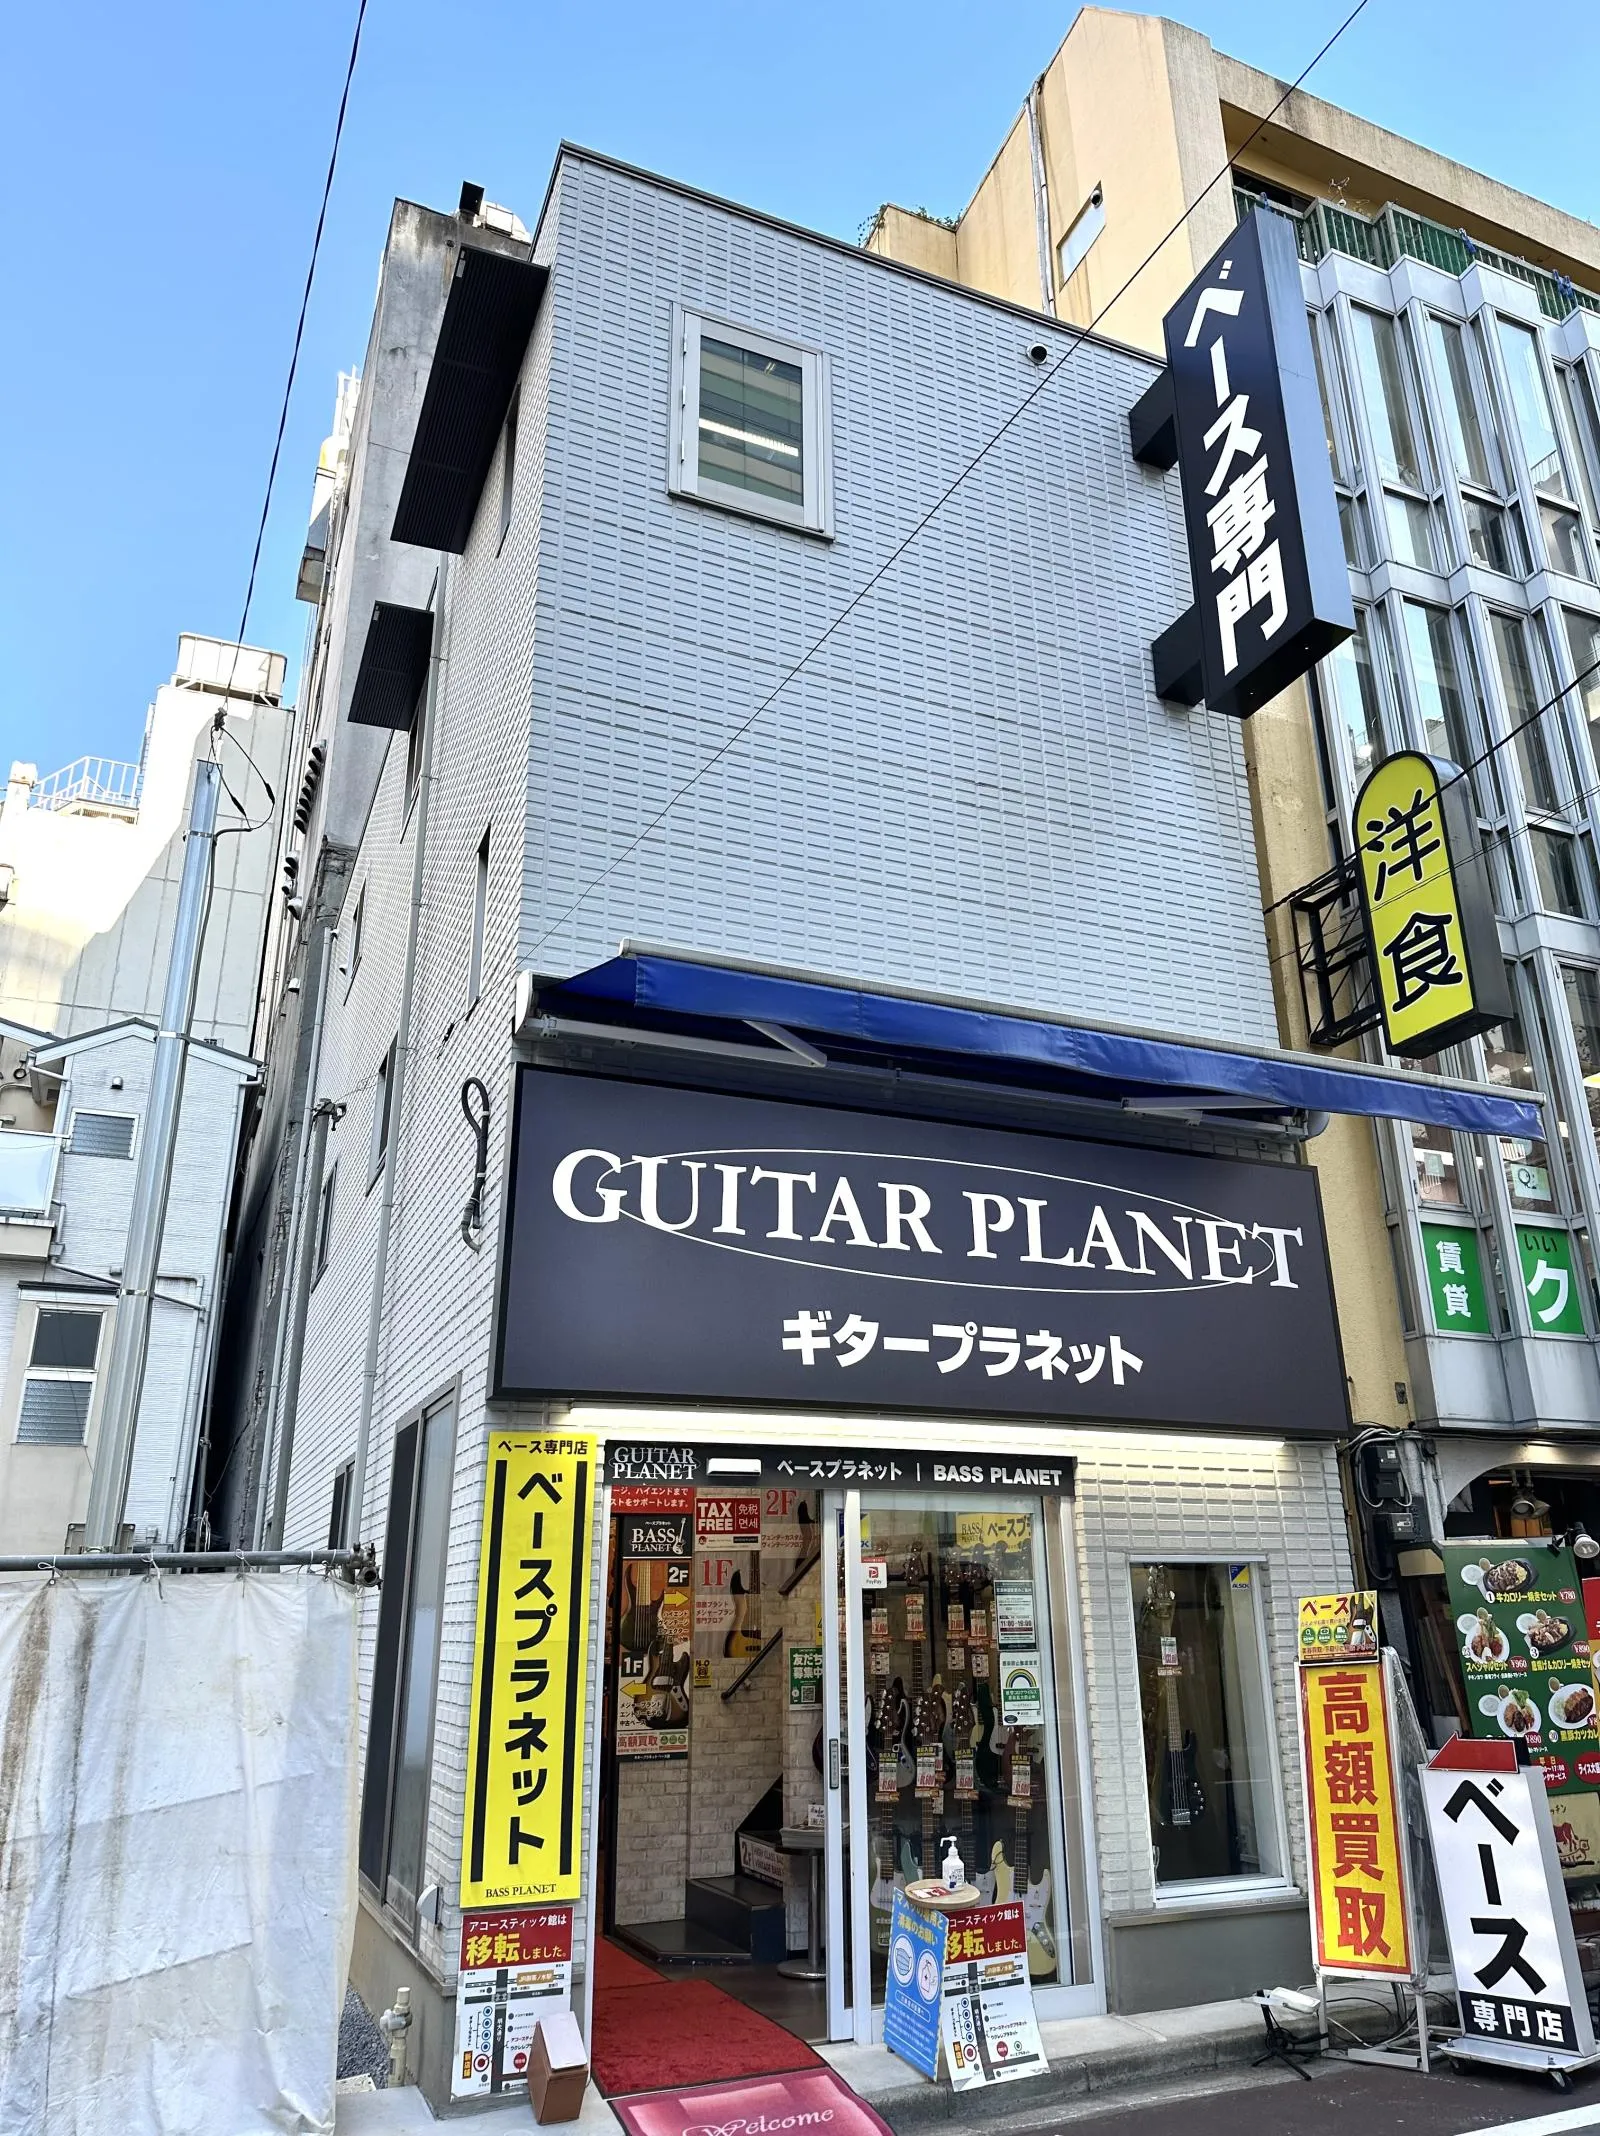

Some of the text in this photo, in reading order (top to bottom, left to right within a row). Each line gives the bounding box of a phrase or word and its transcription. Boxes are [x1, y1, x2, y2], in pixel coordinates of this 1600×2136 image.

[1184, 260, 1288, 676] ベース専門
[1366, 788, 1463, 1013] 洋食
[552, 1148, 1303, 1289] GUITAR PLANET
[1524, 1233, 1558, 1253] いい
[1436, 1240, 1472, 1318] 賃貸
[1527, 1259, 1569, 1324] ク
[781, 1309, 1144, 1387] ギタープラネット
[497, 1439, 588, 1456] ベース専門店
[614, 1446, 696, 1464] GUITAR
[612, 1462, 697, 1480] PLANET
[777, 1459, 903, 1482] ベースプラネット
[933, 1464, 1063, 1487] BASS PLANET
[697, 1502, 732, 1518] TAX
[738, 1503, 759, 1515] 免税
[766, 1488, 797, 1516] 2F
[698, 1518, 734, 1531] FREE
[631, 1528, 676, 1543] BASS
[631, 1543, 672, 1552] PLANET
[668, 1566, 689, 1584] 2F
[702, 1558, 733, 1587] 1F
[1302, 1597, 1350, 1616] ベース
[505, 1471, 564, 1866] ベースプラネット
[623, 1656, 643, 1674] 1F
[792, 1653, 823, 1666] 友だち
[617, 1735, 658, 1749] 高額買取
[1317, 1671, 1392, 1960] 高額買取
[485, 1883, 557, 1899] BASS PLANET
[1442, 1777, 1547, 1996] ベース
[469, 1913, 567, 1933] アコースティック館は
[465, 1932, 567, 1967] 移転しました。
[1470, 1999, 1565, 2043] 専門店
[681, 2107, 835, 2136] Welcome
